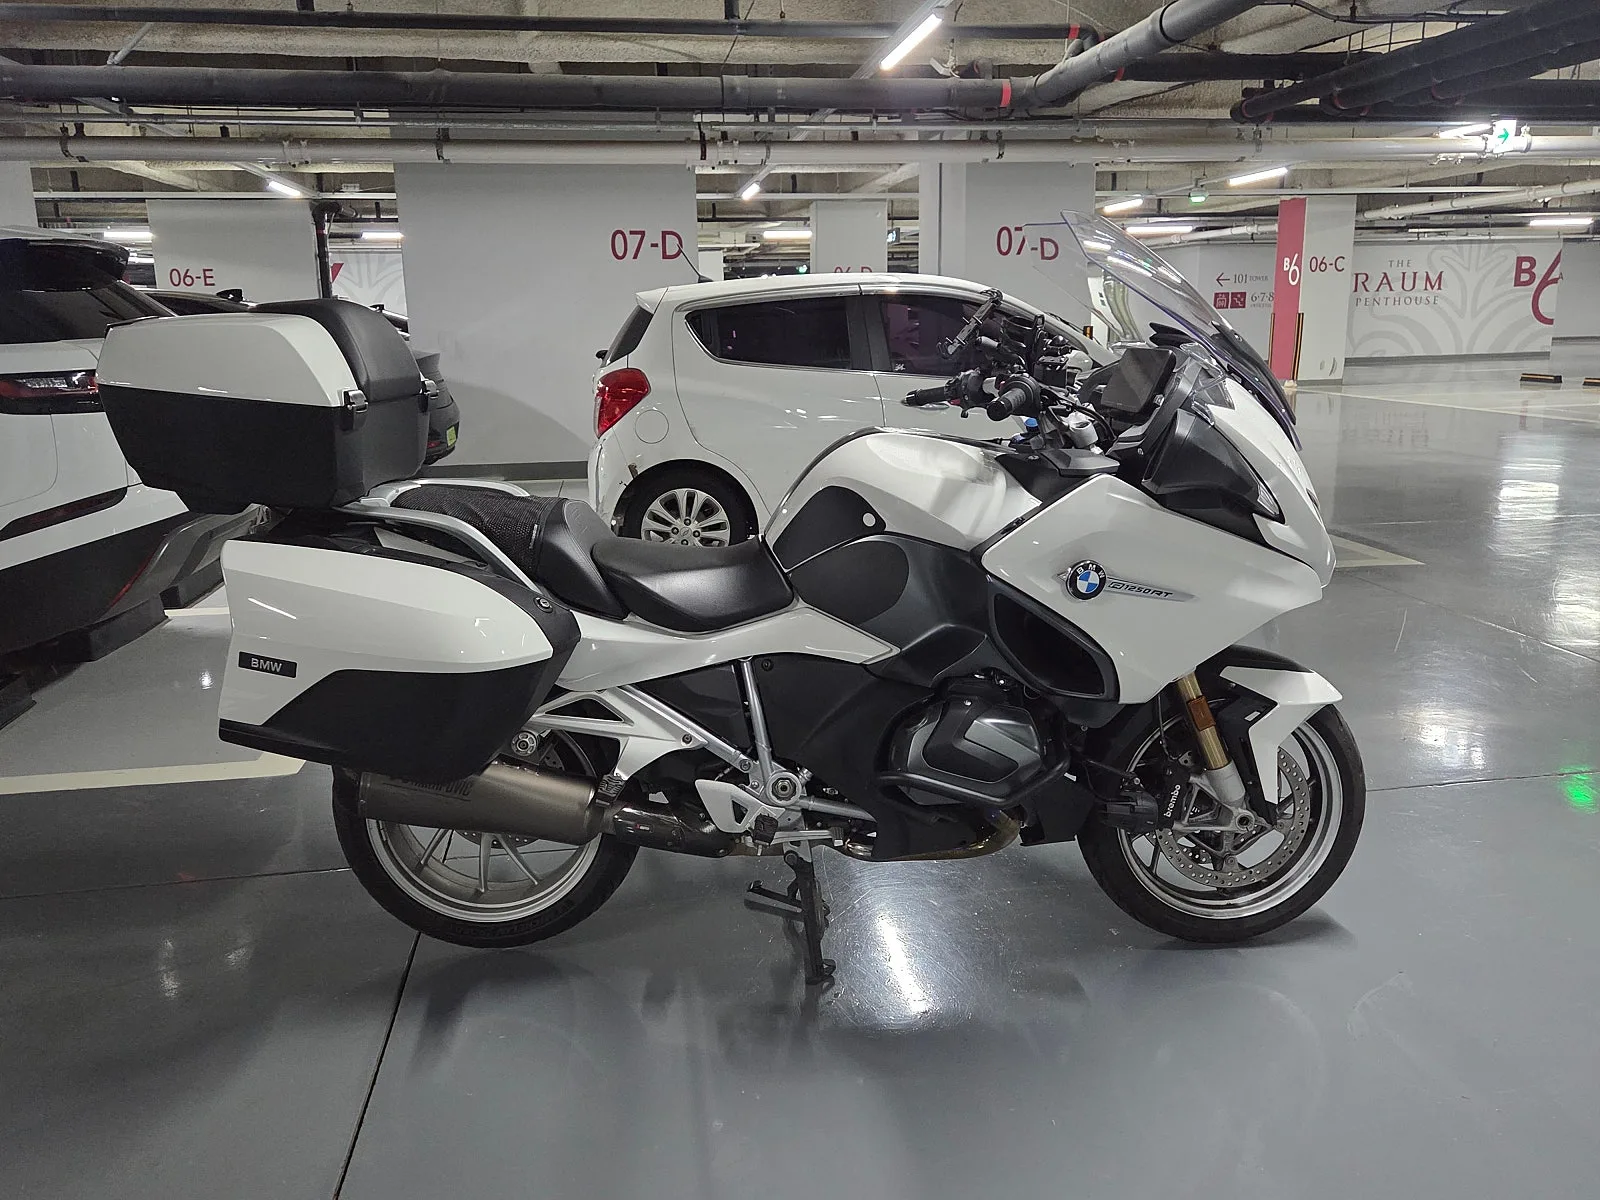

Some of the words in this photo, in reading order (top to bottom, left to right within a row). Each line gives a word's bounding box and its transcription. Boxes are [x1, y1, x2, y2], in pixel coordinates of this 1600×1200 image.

[610, 229, 684, 260] 07-D
[996, 226, 1059, 261] 07-D
[1283, 253, 1300, 286] B6
[1309, 256, 1346, 273] 06-C
[1388, 259, 1412, 268] THE
[169, 268, 216, 287] 06-E
[1233, 273, 1248, 284] 101
[1353, 270, 1444, 293] RAUM
[1355, 295, 1439, 307] PENTHOUSE
[1076, 563, 1106, 579] BMW
[251, 657, 283, 673] BMW
[1163, 784, 1181, 818] brembo
